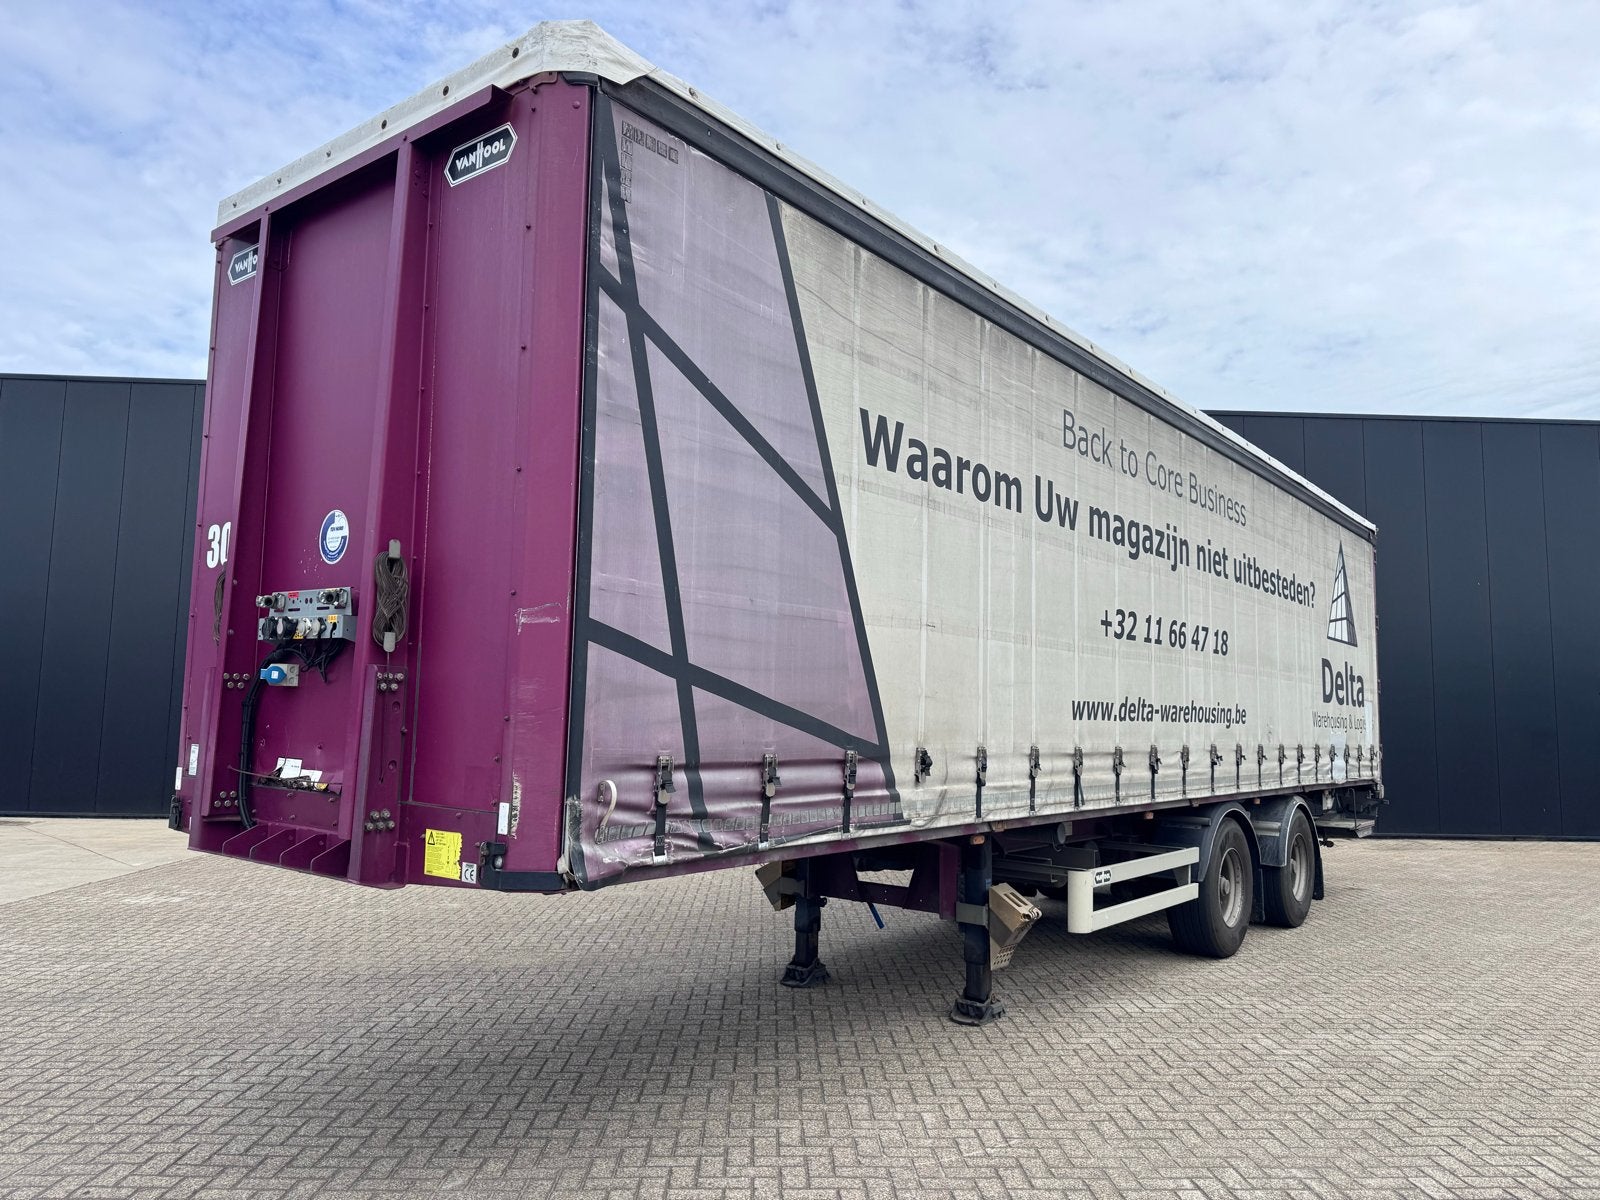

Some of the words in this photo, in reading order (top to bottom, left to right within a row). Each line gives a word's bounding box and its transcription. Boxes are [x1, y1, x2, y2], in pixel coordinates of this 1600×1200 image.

[1063, 409, 1113, 468] Back
[1119, 438, 1138, 478] to
[1145, 450, 1183, 498] Core
[1189, 472, 1247, 527] Business
[859, 407, 1022, 513] Waarom
[1035, 474, 1079, 531] Uw
[1089, 505, 1190, 572] magazijn
[1196, 538, 1229, 580] niet
[1233, 552, 1316, 609] uitbesteden?
[1100, 608, 1138, 642] +32
[1143, 614, 1163, 646] 11
[1168, 619, 1187, 650] 66
[1191, 624, 1209, 652] 47
[1212, 629, 1229, 656] 18
[1321, 657, 1365, 708] Delta
[1071, 696, 1247, 729] www.delta-warehousing.be
[1312, 711, 1348, 733] Warehousing
